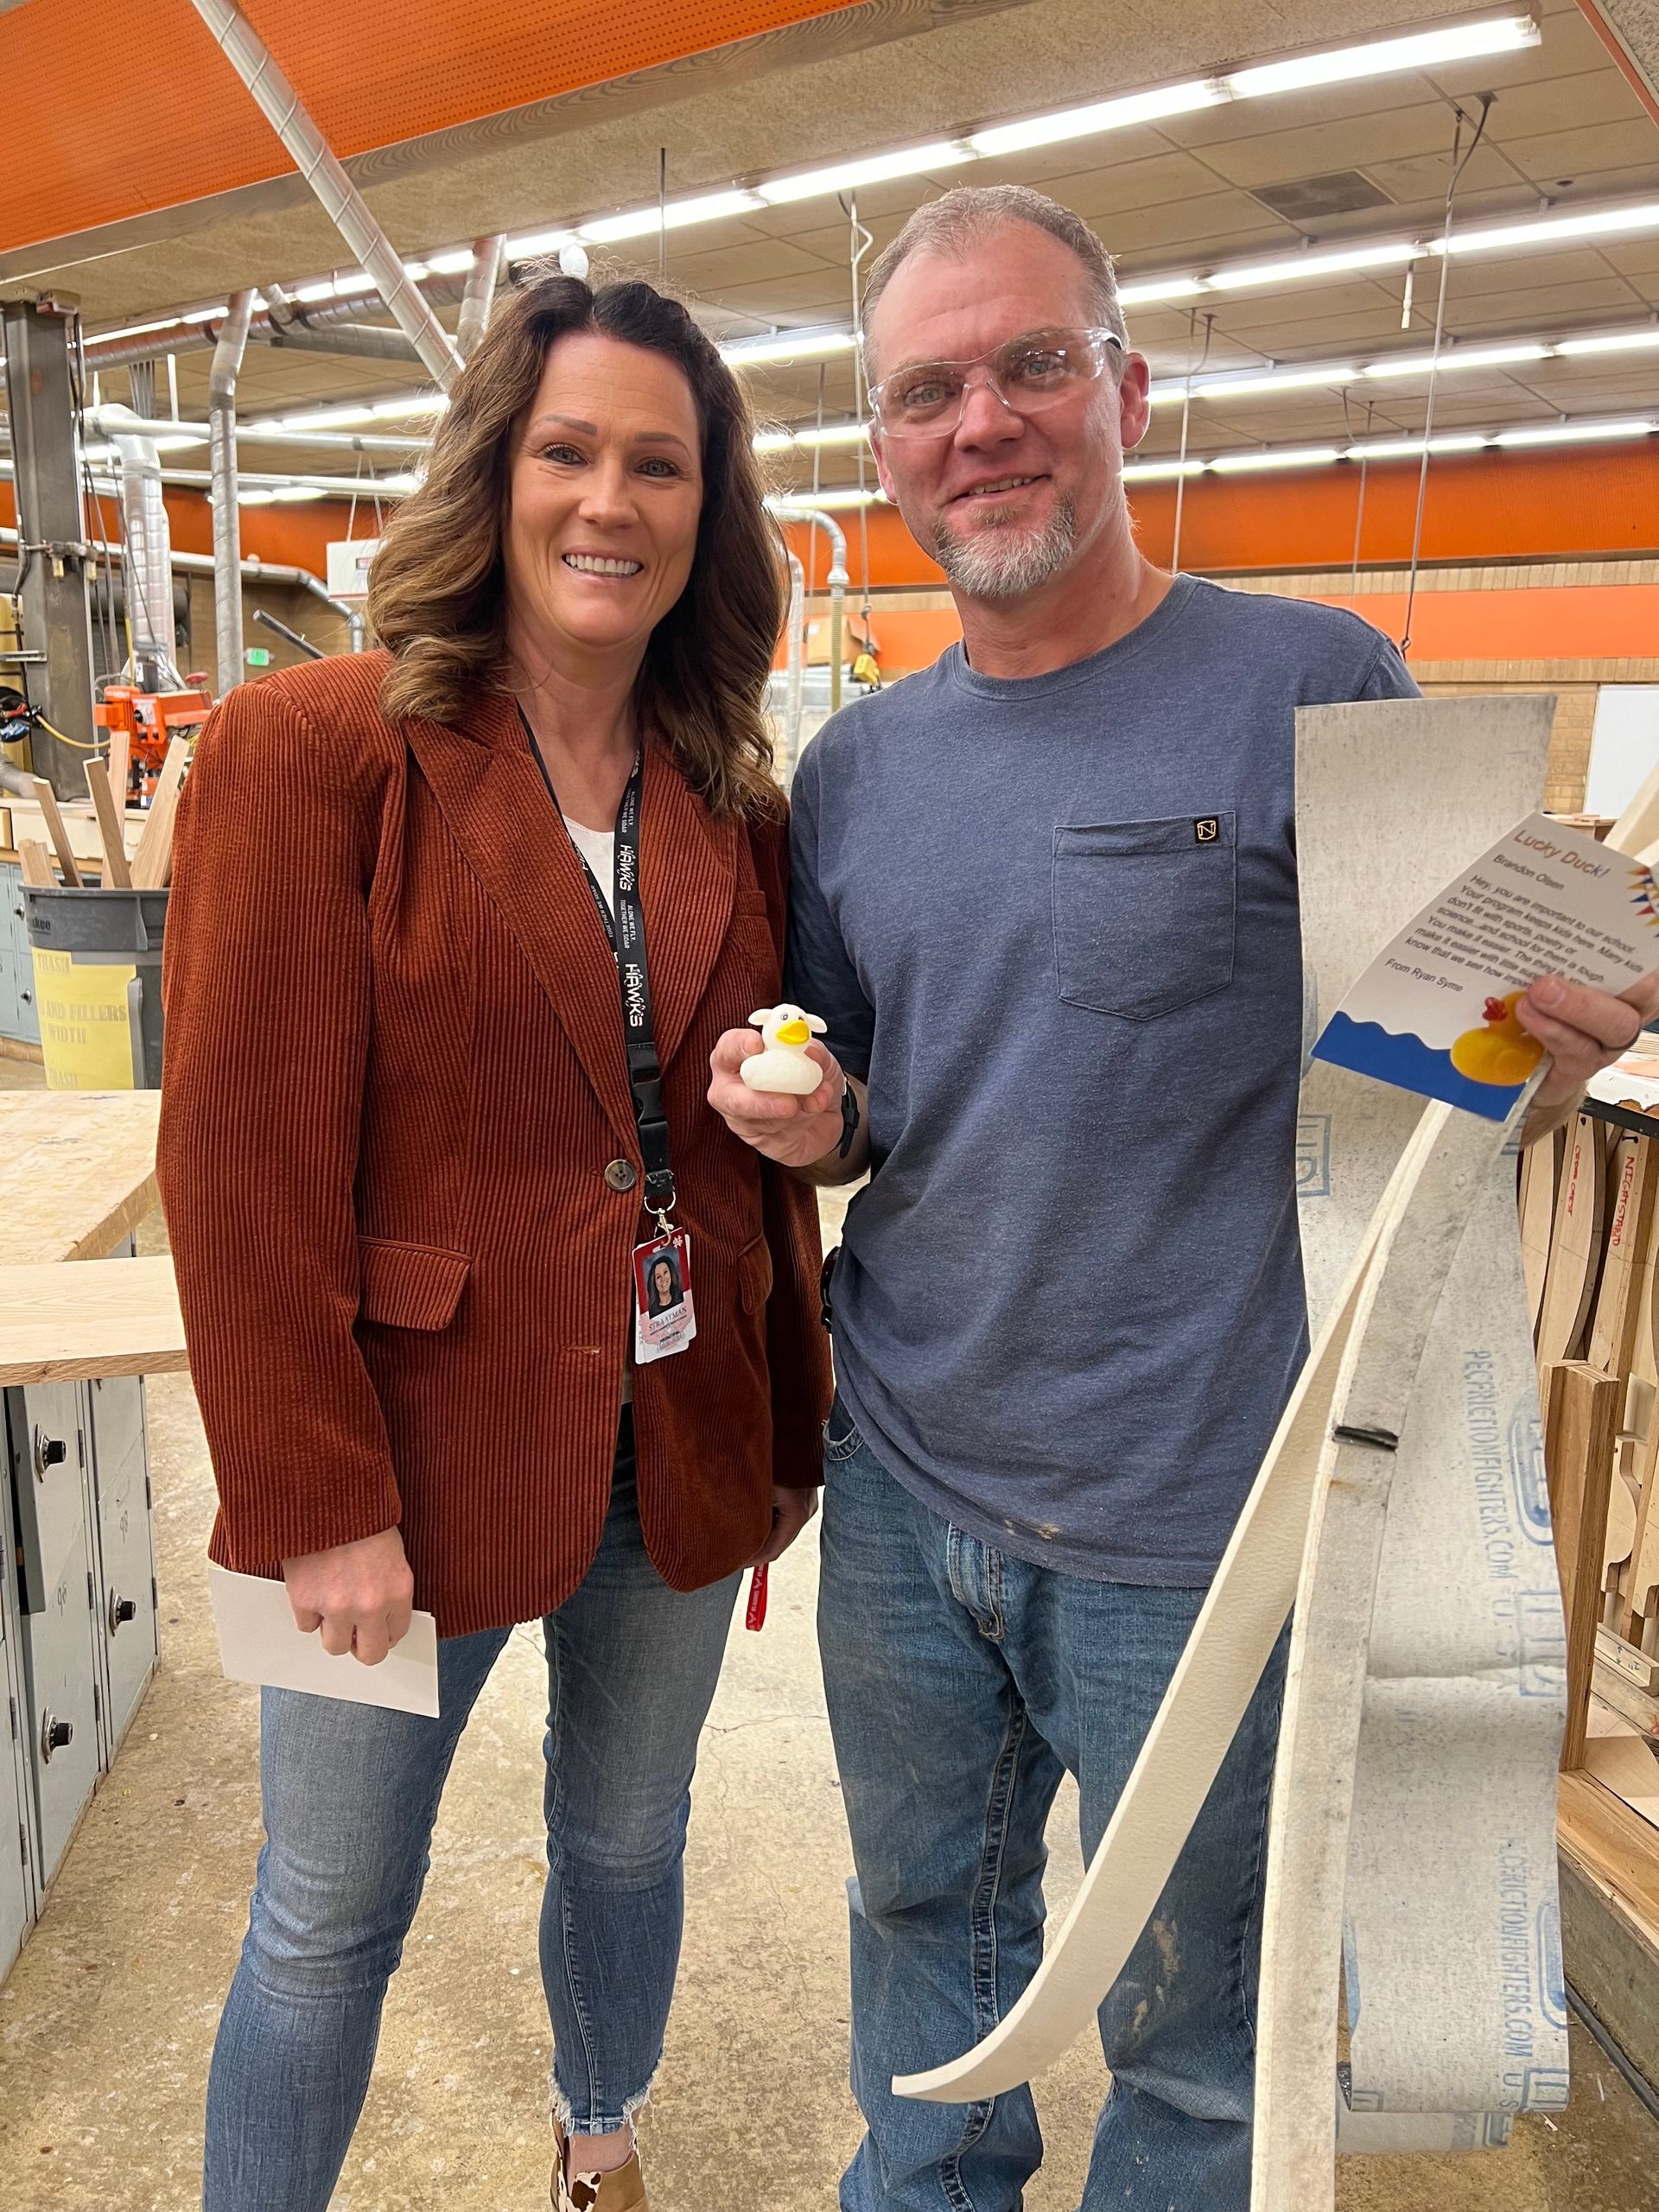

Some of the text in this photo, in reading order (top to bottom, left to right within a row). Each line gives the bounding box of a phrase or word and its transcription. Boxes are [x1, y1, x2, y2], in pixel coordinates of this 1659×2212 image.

[1515, 831, 1611, 878] Lucky Duck!
[616, 844, 636, 891] HAWKS
[1493, 855, 1564, 890] Brandon Olsen
[620, 899, 628, 924] TOGETHER
[1446, 898, 1474, 911] don't
[622, 925, 629, 933] WE
[629, 921, 636, 930] WE
[37, 953, 70, 974] TRASH
[1384, 959, 1464, 992] From Ryan Syme
[624, 963, 646, 1027] HAWKS
[48, 1023, 86, 1045] WIDTH
[649, 1306, 687, 1332] STRAATMAN
